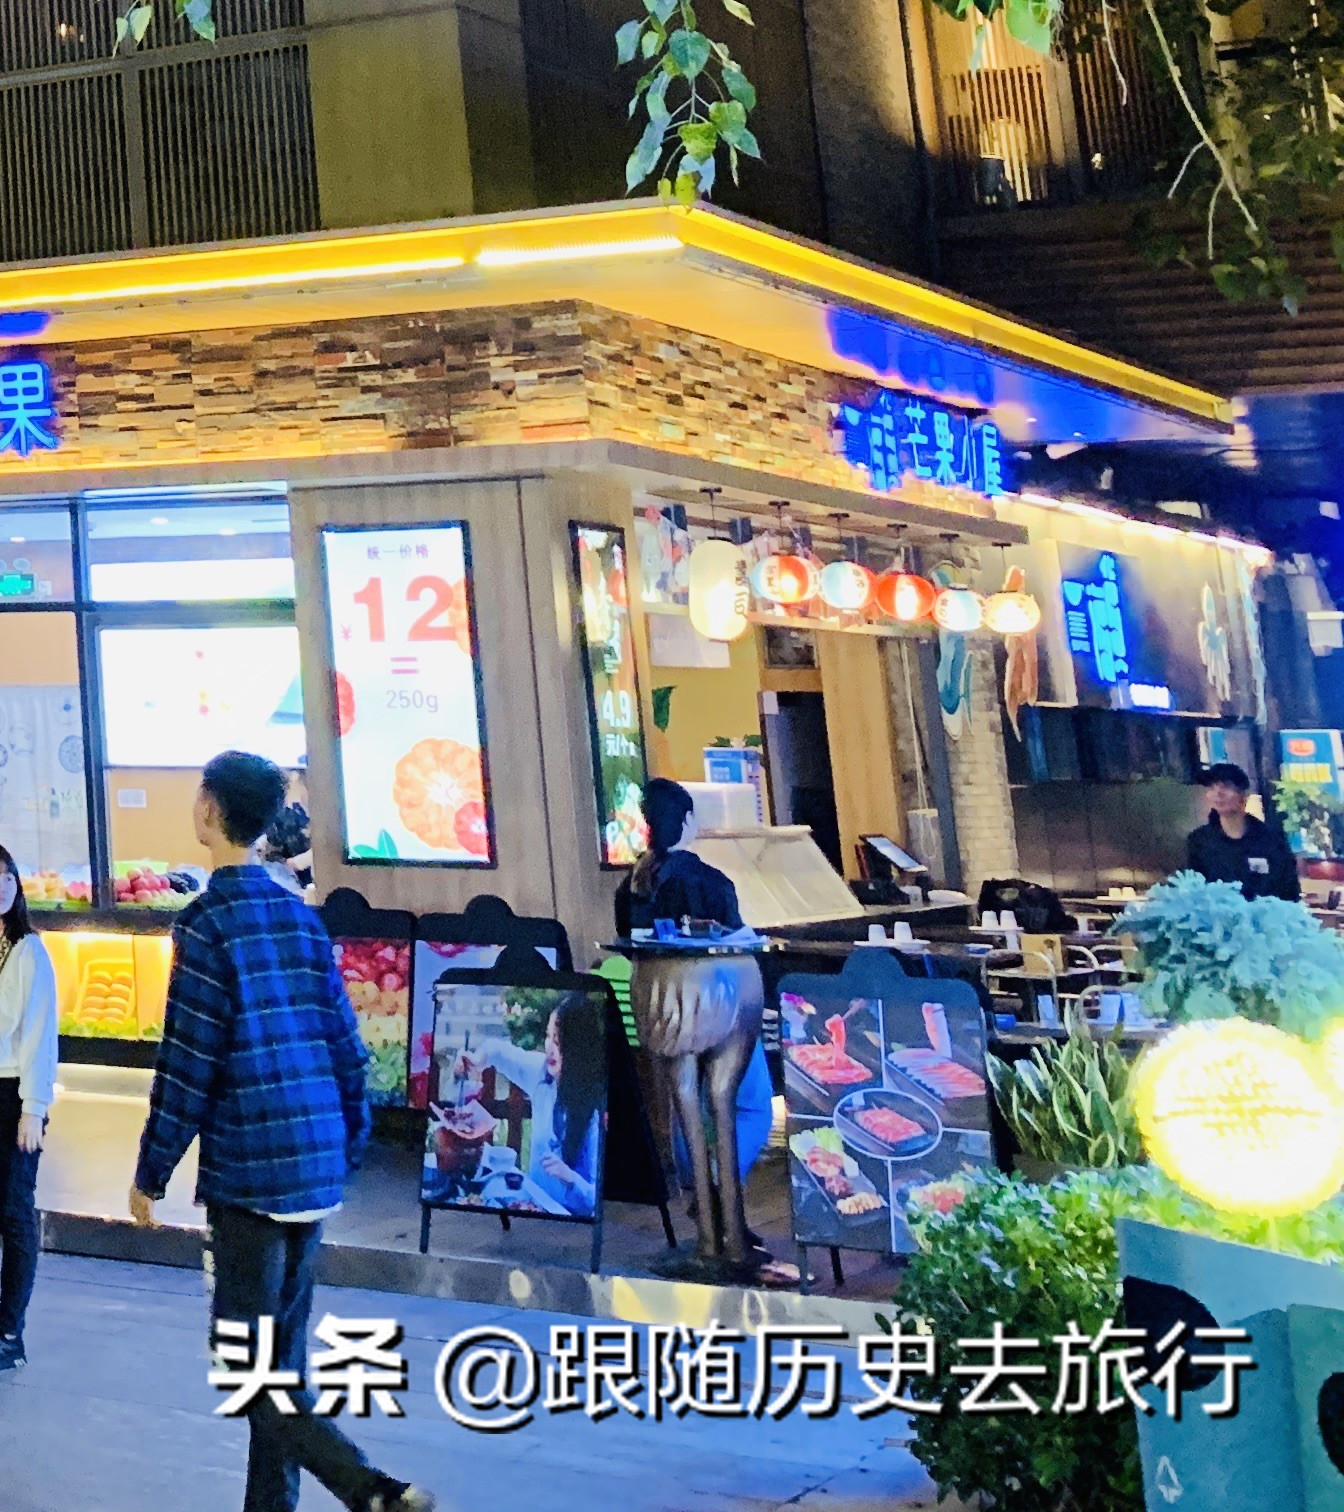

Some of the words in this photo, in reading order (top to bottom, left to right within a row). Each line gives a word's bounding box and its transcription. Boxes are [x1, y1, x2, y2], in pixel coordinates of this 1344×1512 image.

[900, 398, 1004, 496] 芒果小屋
[353, 575, 458, 643] 12
[385, 690, 440, 714] 250g
[602, 690, 632, 728] 4.9
